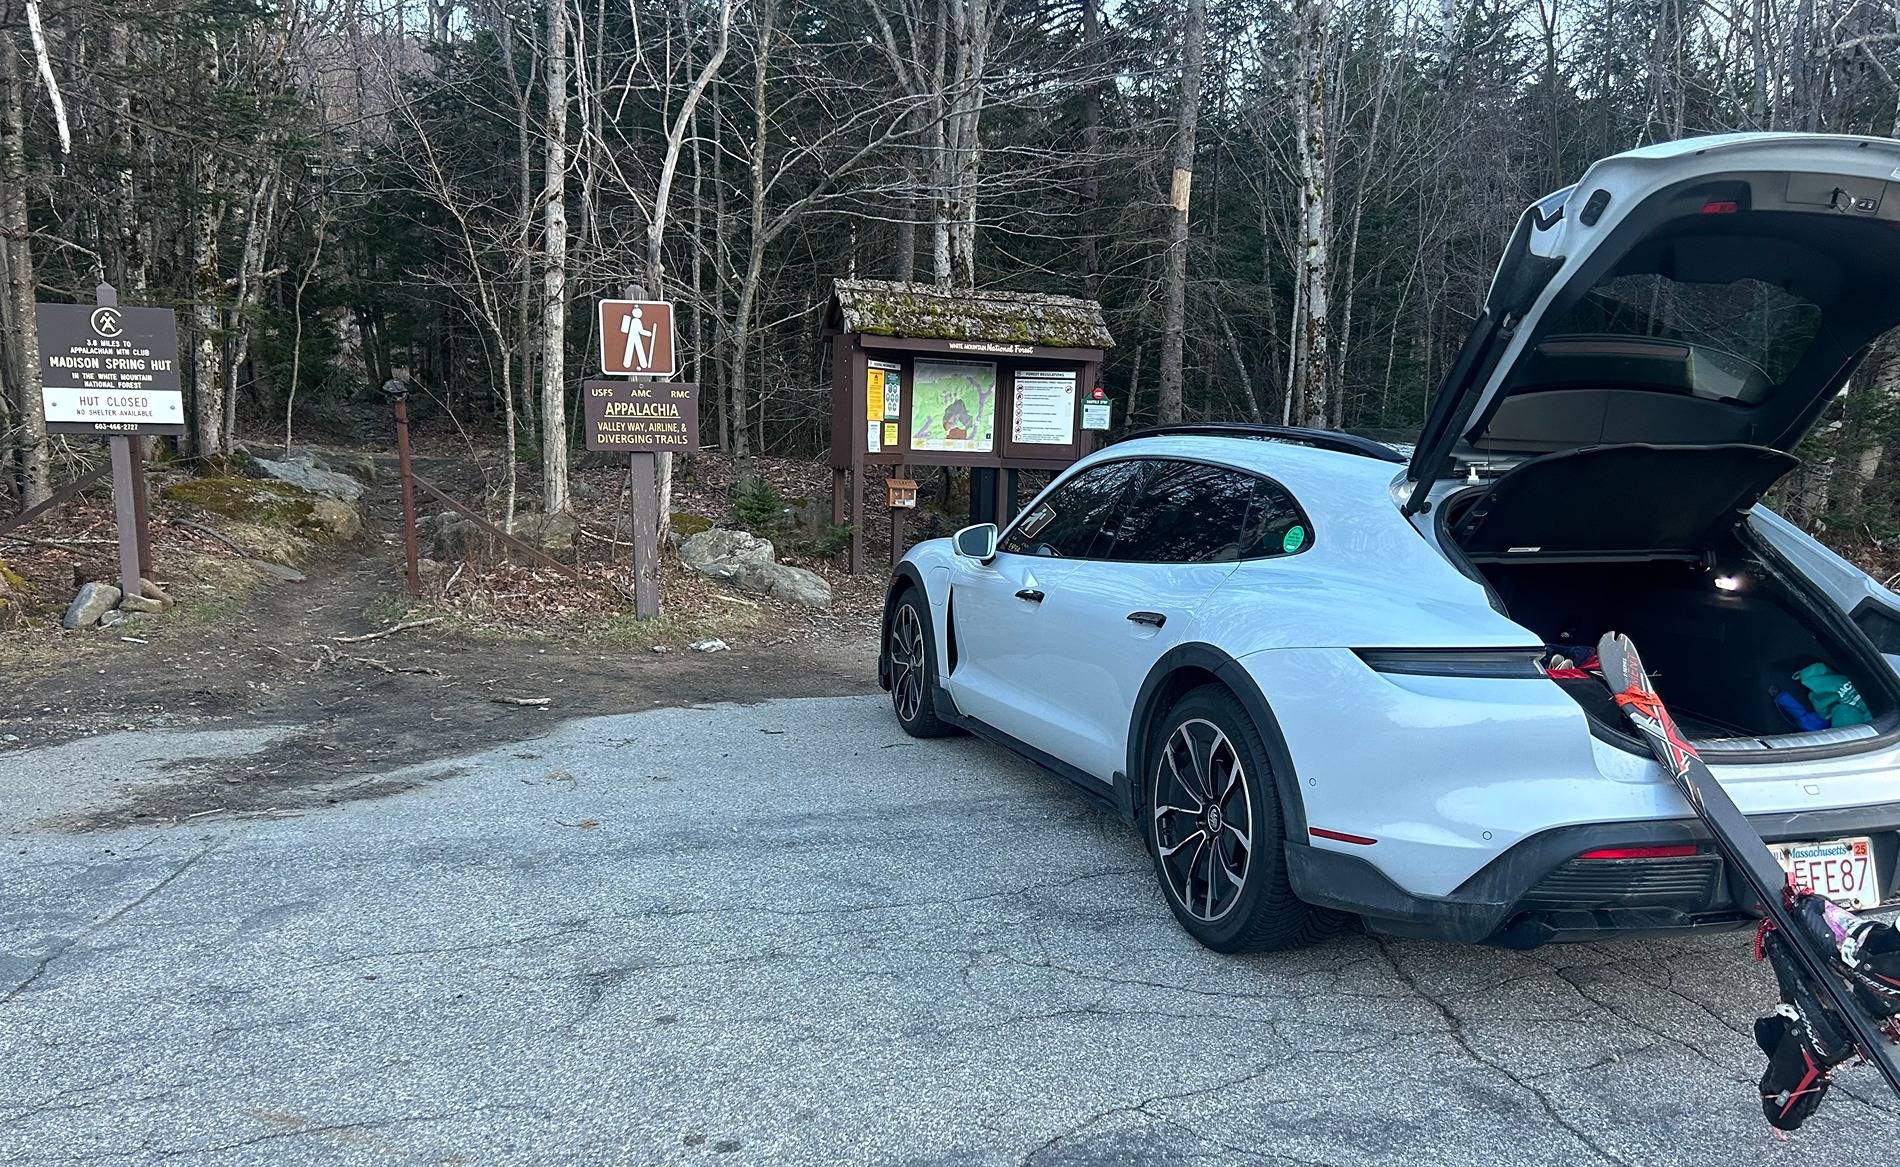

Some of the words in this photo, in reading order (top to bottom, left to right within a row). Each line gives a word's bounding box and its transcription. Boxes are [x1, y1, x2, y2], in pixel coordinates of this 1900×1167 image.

[70, 347, 113, 355] APPALACHIAN
[133, 348, 150, 356] CLUB
[948, 342, 963, 350] WHITE
[964, 343, 986, 351] MOUNTAIN
[986, 343, 1014, 353] National
[1014, 344, 1034, 354] Forest
[50, 356, 99, 369] MADISON
[105, 358, 145, 370] SPRING
[151, 360, 172, 371] HUT
[82, 372, 94, 380] THE
[118, 381, 142, 389] FOREST
[591, 389, 613, 397] USFS
[631, 389, 652, 398] AMC
[671, 390, 690, 399] RMC
[79, 396, 99, 406] HUT
[107, 397, 148, 407] CLOSED
[605, 402, 679, 416] APPALACHIA
[94, 423, 138, 431] 603-466-2727
[597, 421, 625, 432] VALLEY
[627, 422, 648, 433] WAY,
[649, 422, 680, 433] AIRLINE,
[681, 423, 687, 433] &
[597, 433, 653, 444] DIVERGING
[655, 434, 688, 445] TRAILS
[1855, 844, 1866, 855] 25
